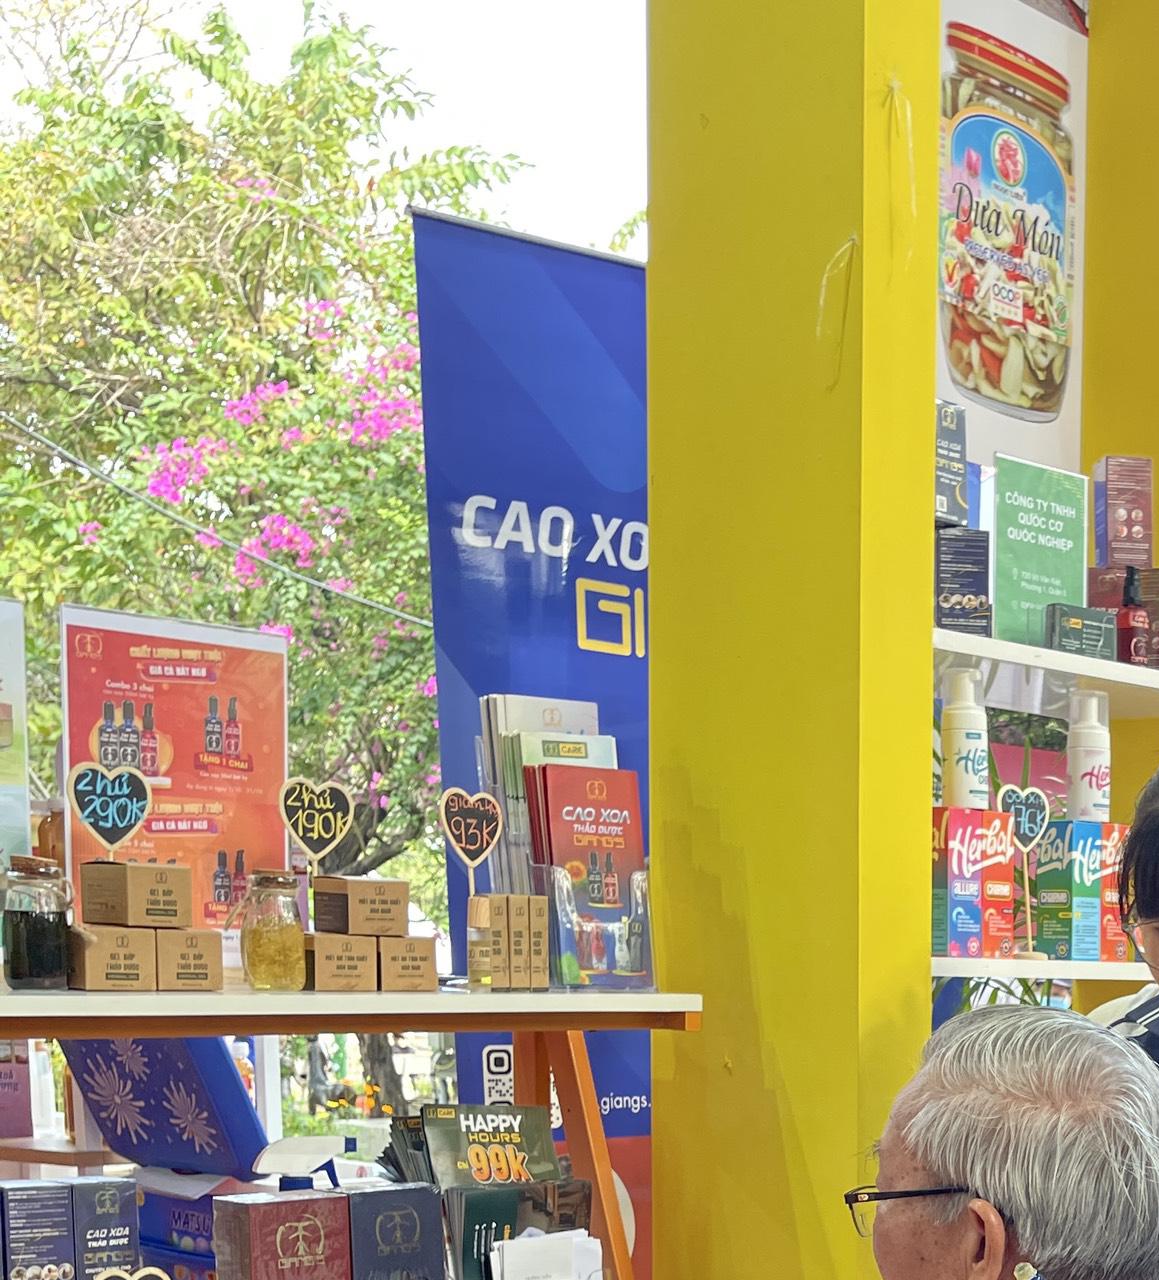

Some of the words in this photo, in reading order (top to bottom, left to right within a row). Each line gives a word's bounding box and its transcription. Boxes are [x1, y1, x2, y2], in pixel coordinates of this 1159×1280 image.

[952, 182, 1003, 237] Dưa
[1012, 208, 1061, 261] Món
[1005, 491, 1035, 509] CÔNG
[1035, 499, 1049, 512] TY
[1050, 501, 1076, 519] TNHH
[462, 494, 574, 558] CAO
[575, 577, 646, 658] GI
[76, 770, 93, 790] 2
[287, 784, 302, 806] 2
[80, 795, 148, 828] 290K
[562, 806, 596, 821] CAO
[600, 807, 630, 824] XOA
[289, 809, 349, 840] 190K
[451, 816, 498, 850] 93K
[573, 822, 596, 834] THẢO
[948, 818, 1014, 878] Herbal
[601, 1092, 651, 1115] giangs.
[459, 1113, 522, 1132] HAPPY
[468, 1132, 522, 1143] HOURS
[467, 1143, 534, 1184] 99k
[86, 1229, 107, 1239] CAO
[109, 1226, 130, 1237] XOA
[88, 1239, 107, 1249] THẢO
